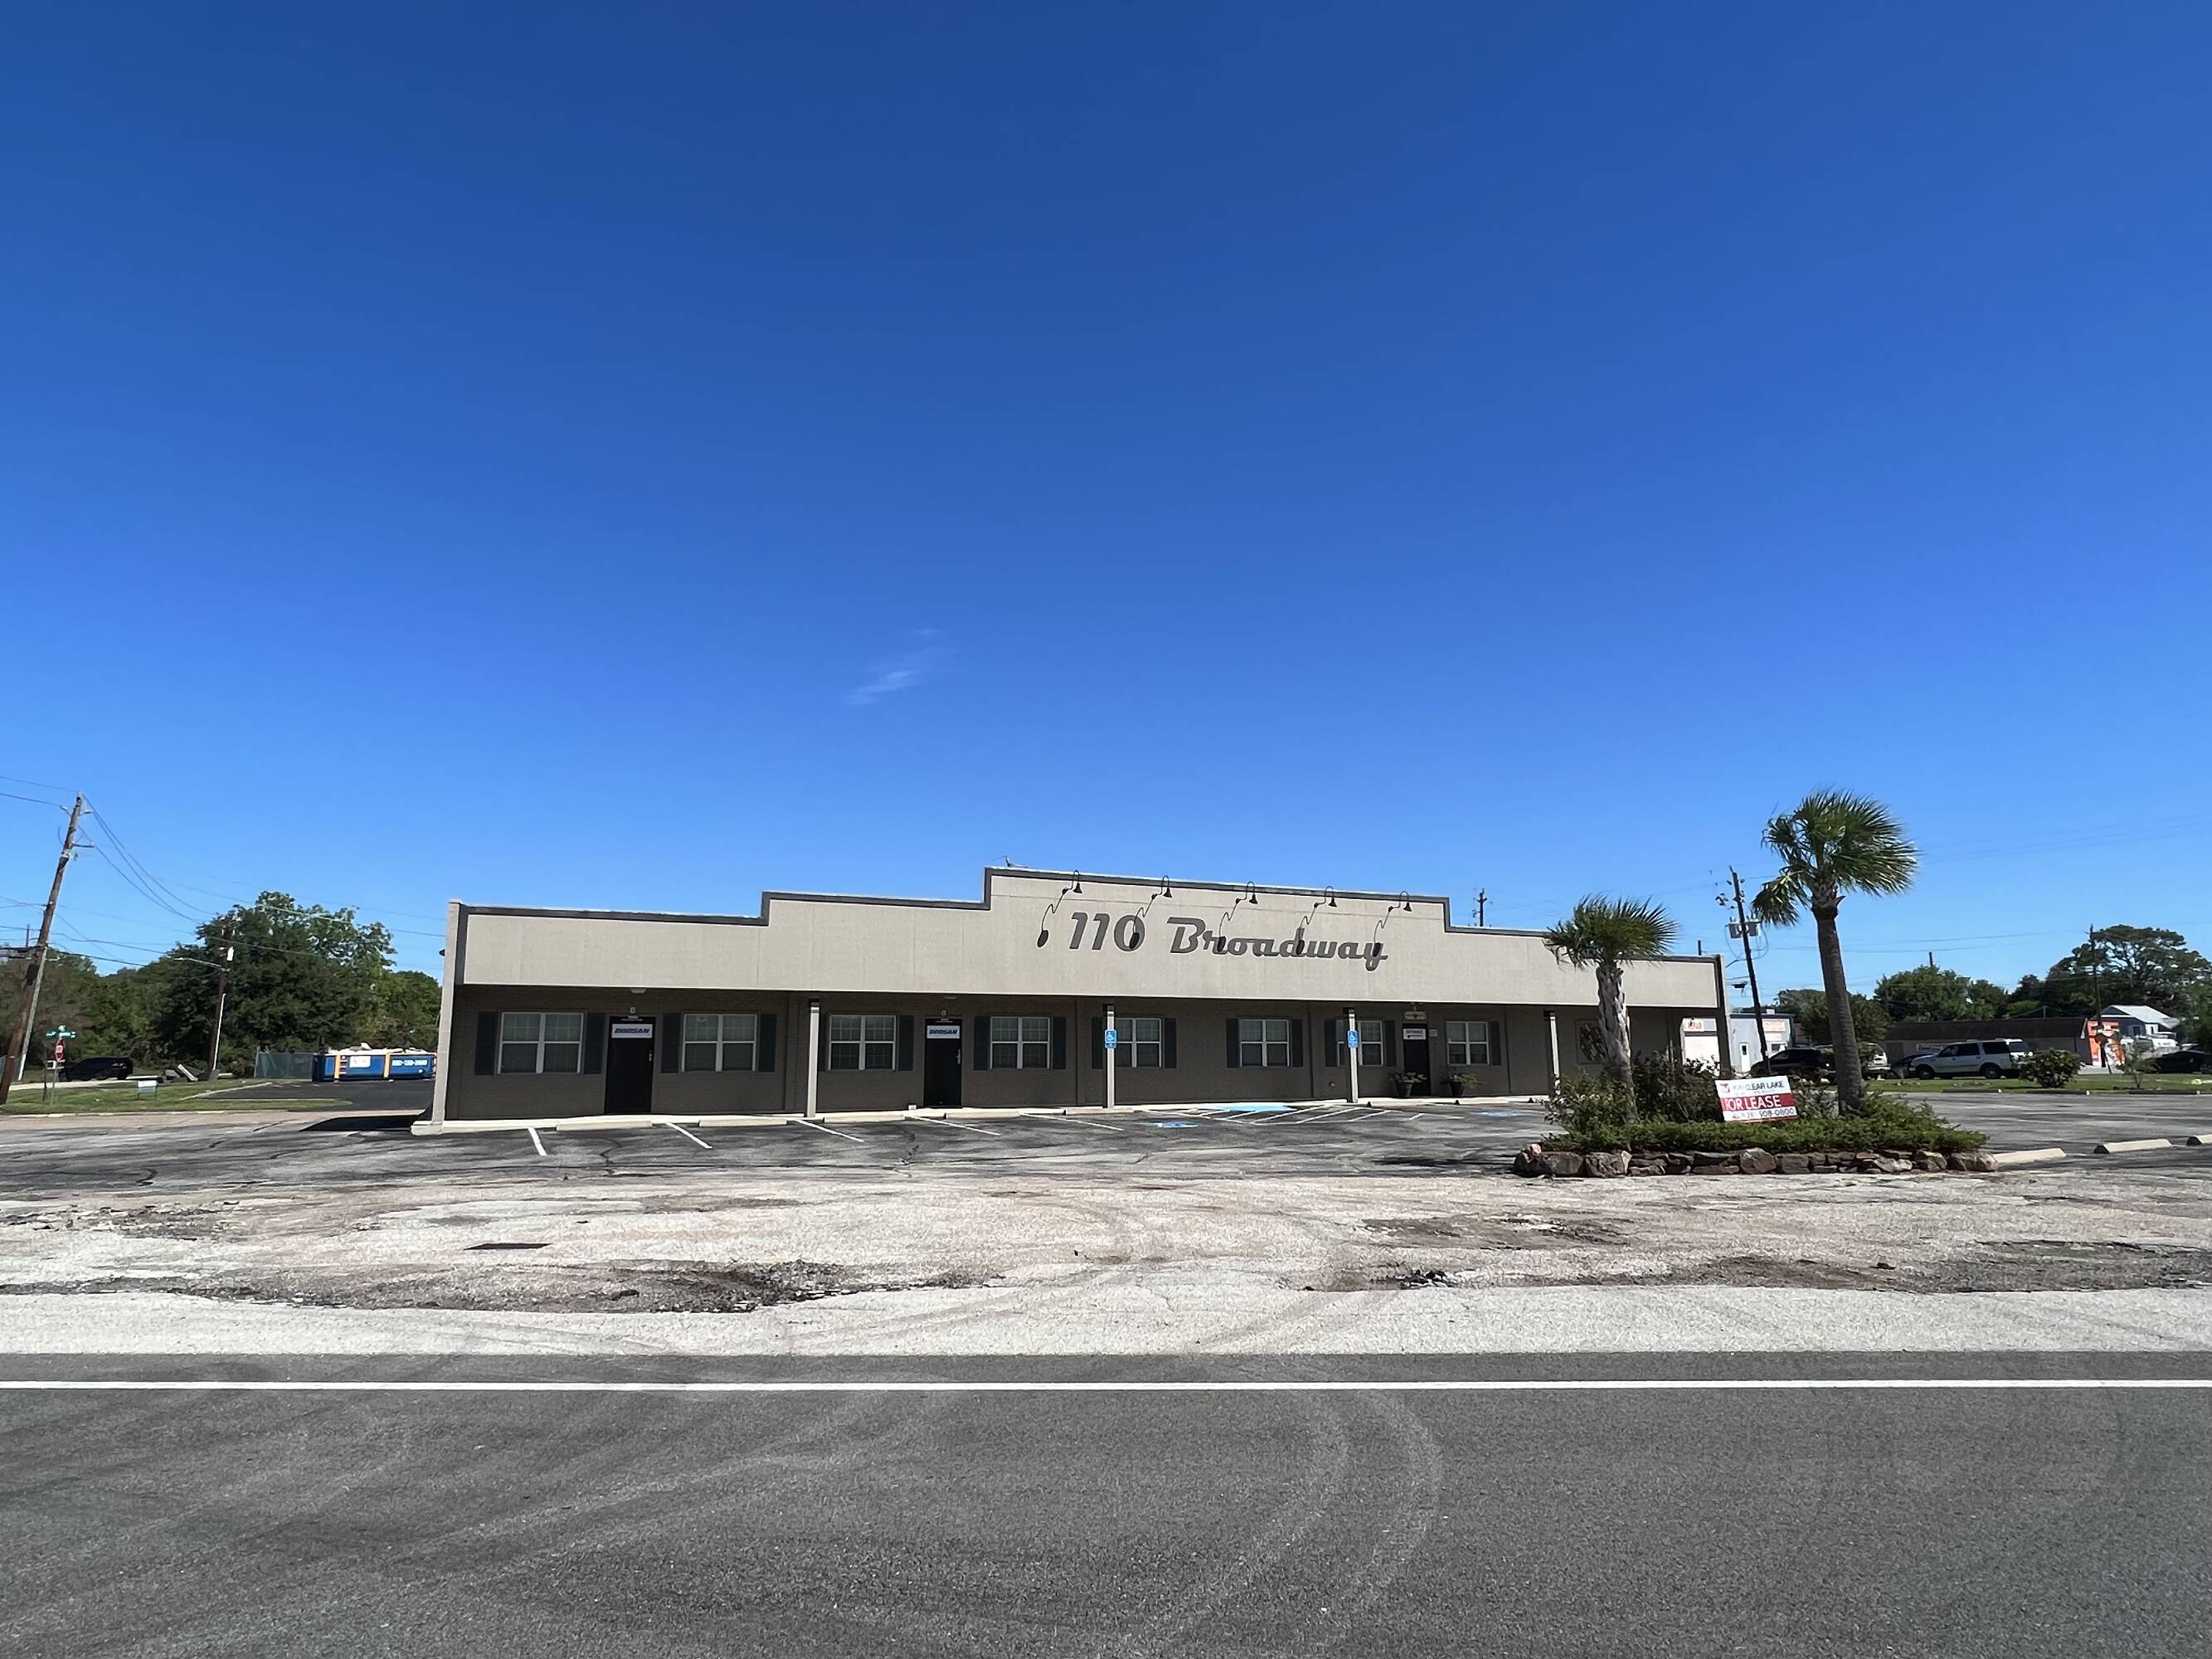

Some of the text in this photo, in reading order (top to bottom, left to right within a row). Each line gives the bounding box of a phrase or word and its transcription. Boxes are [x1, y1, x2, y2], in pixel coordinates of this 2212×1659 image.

[1069, 912, 1388, 971] 110 Broadway
[1744, 1082, 1766, 1091] CLEAR
[1744, 1095, 1782, 1110] LEASE
